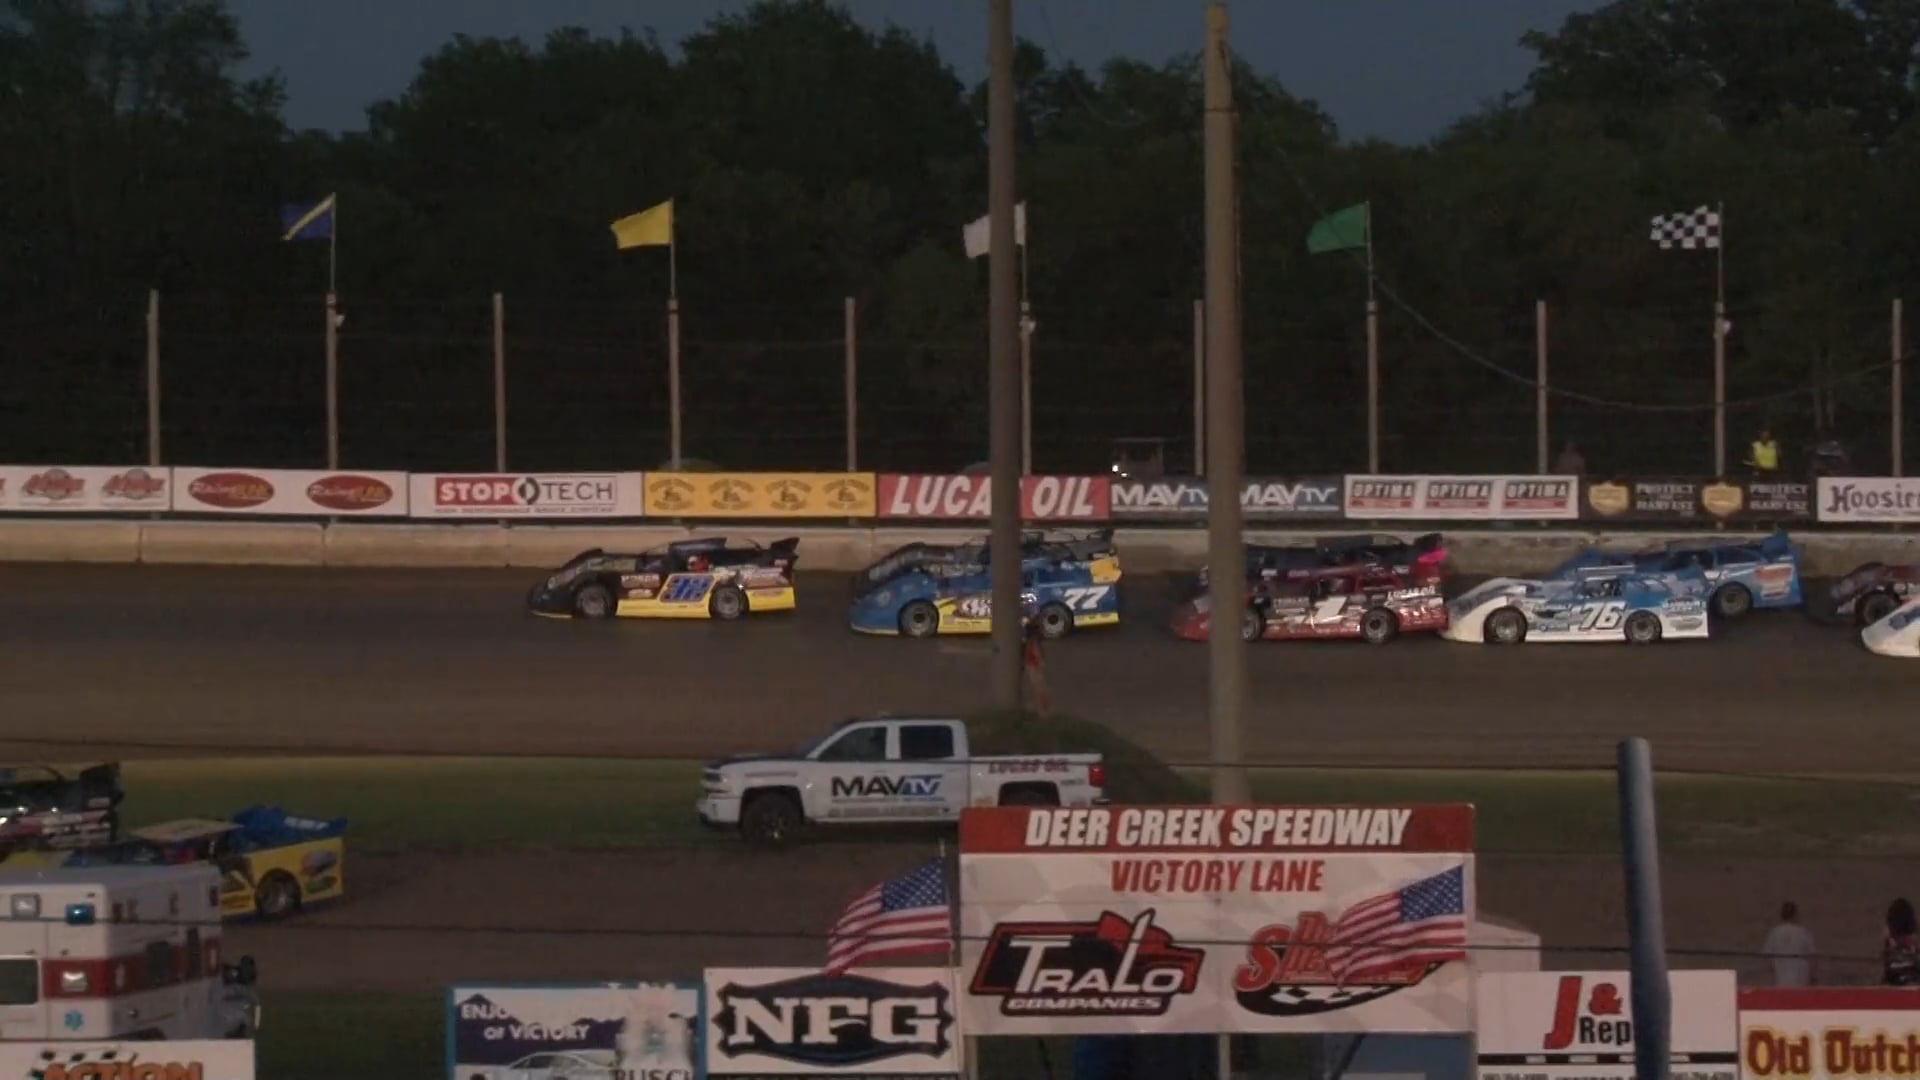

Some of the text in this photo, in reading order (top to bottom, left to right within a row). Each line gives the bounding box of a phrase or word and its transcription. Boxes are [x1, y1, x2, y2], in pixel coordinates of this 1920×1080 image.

[439, 482, 613, 501] STOP TECH
[890, 476, 992, 516] LUCA
[1032, 476, 1093, 517] OIL
[1351, 483, 1414, 498] OPTIMA
[1427, 483, 1489, 498] OPTIMA
[1503, 483, 1568, 498] OPTIMA
[1825, 484, 1920, 513] Hoosie
[1064, 587, 1112, 610] 77
[1313, 597, 1348, 620] 1
[1578, 602, 1626, 630] 76
[831, 776, 944, 798] MAVTV
[1025, 808, 1412, 847] DEER CREEK SPEEDWAY
[1111, 860, 1325, 892] VICTORY LANE
[1006, 997, 1160, 1010] COMPANIES
[1543, 976, 1622, 1050] J&
[508, 1022, 591, 1041] VICTORY
[728, 997, 940, 1044] NFG
[1579, 1017, 1632, 1045] Rep
[1747, 1029, 1810, 1076] Old
